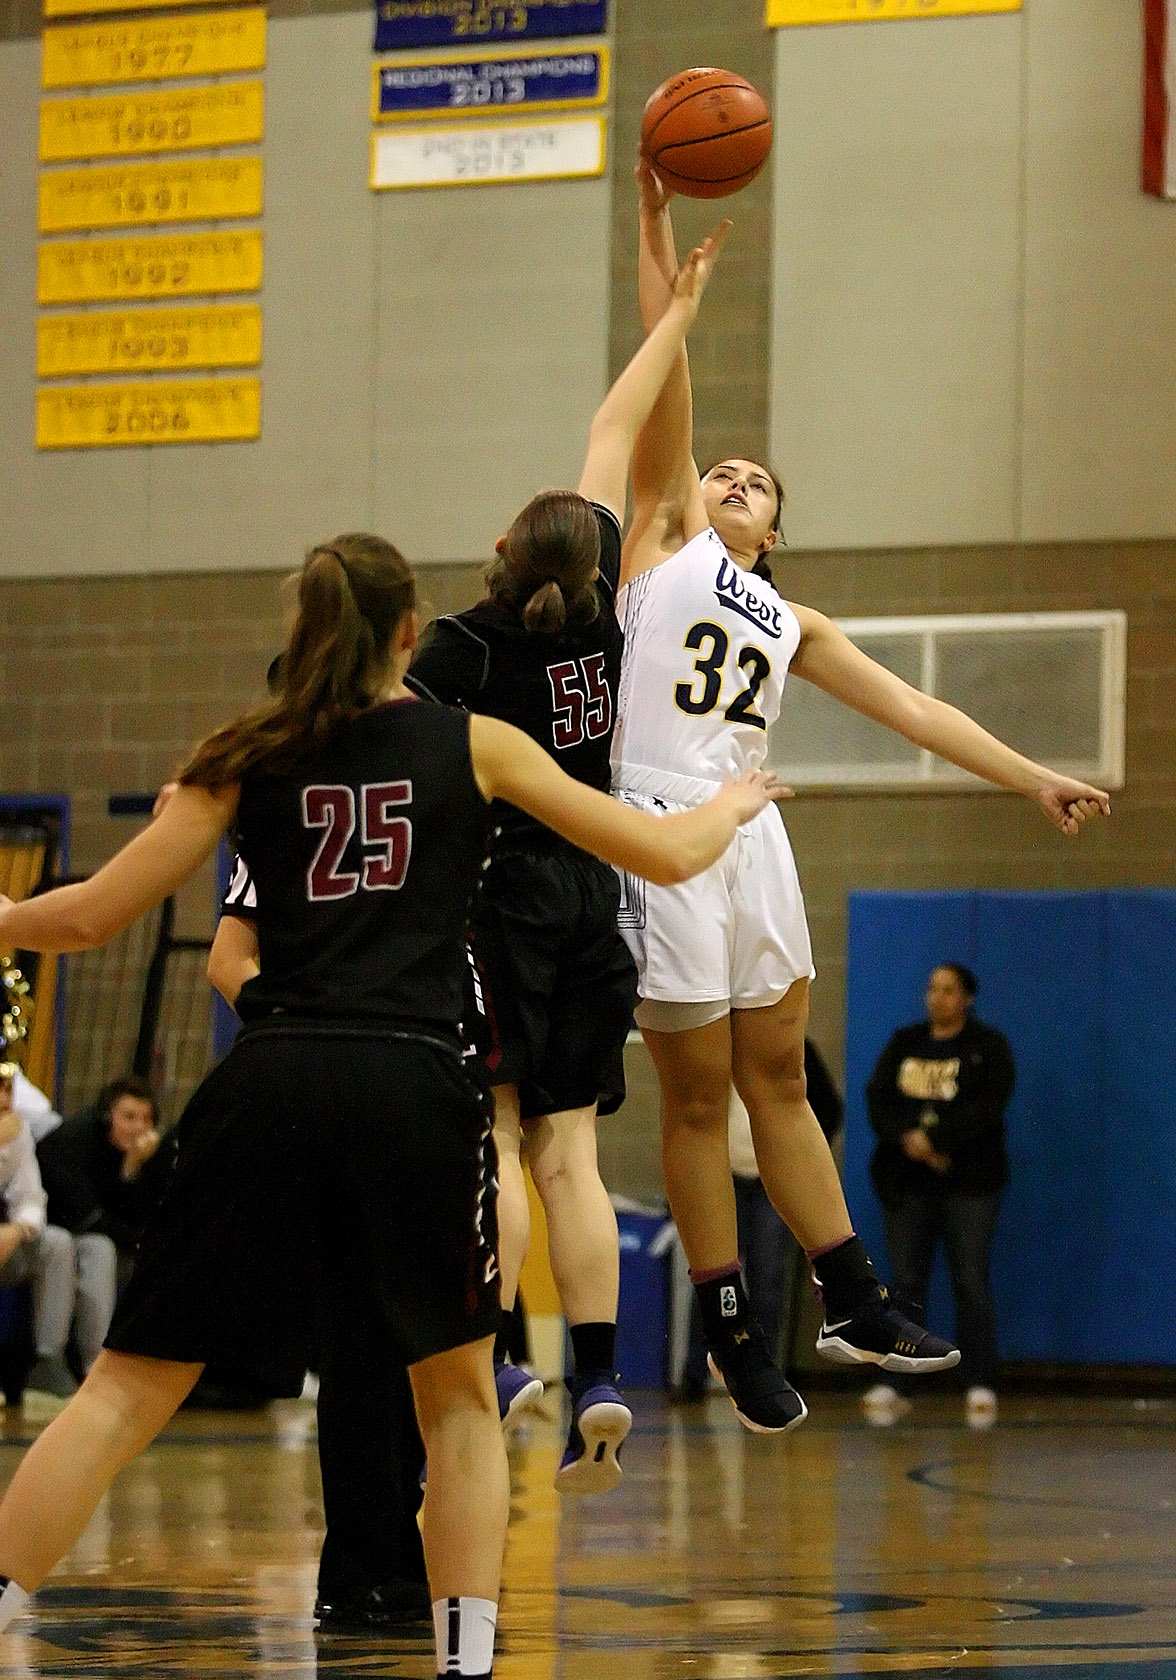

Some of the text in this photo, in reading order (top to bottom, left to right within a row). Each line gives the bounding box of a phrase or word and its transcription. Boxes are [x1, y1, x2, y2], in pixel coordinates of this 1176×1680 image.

[453, 9, 528, 35] 2013
[111, 43, 194, 70] 1977
[384, 54, 595, 88] REGIONAL CHAMPIONS
[450, 79, 526, 106] 2013
[714, 557, 783, 632] West
[546, 651, 613, 750] 55
[673, 618, 772, 732] 32
[301, 780, 413, 902] 25
